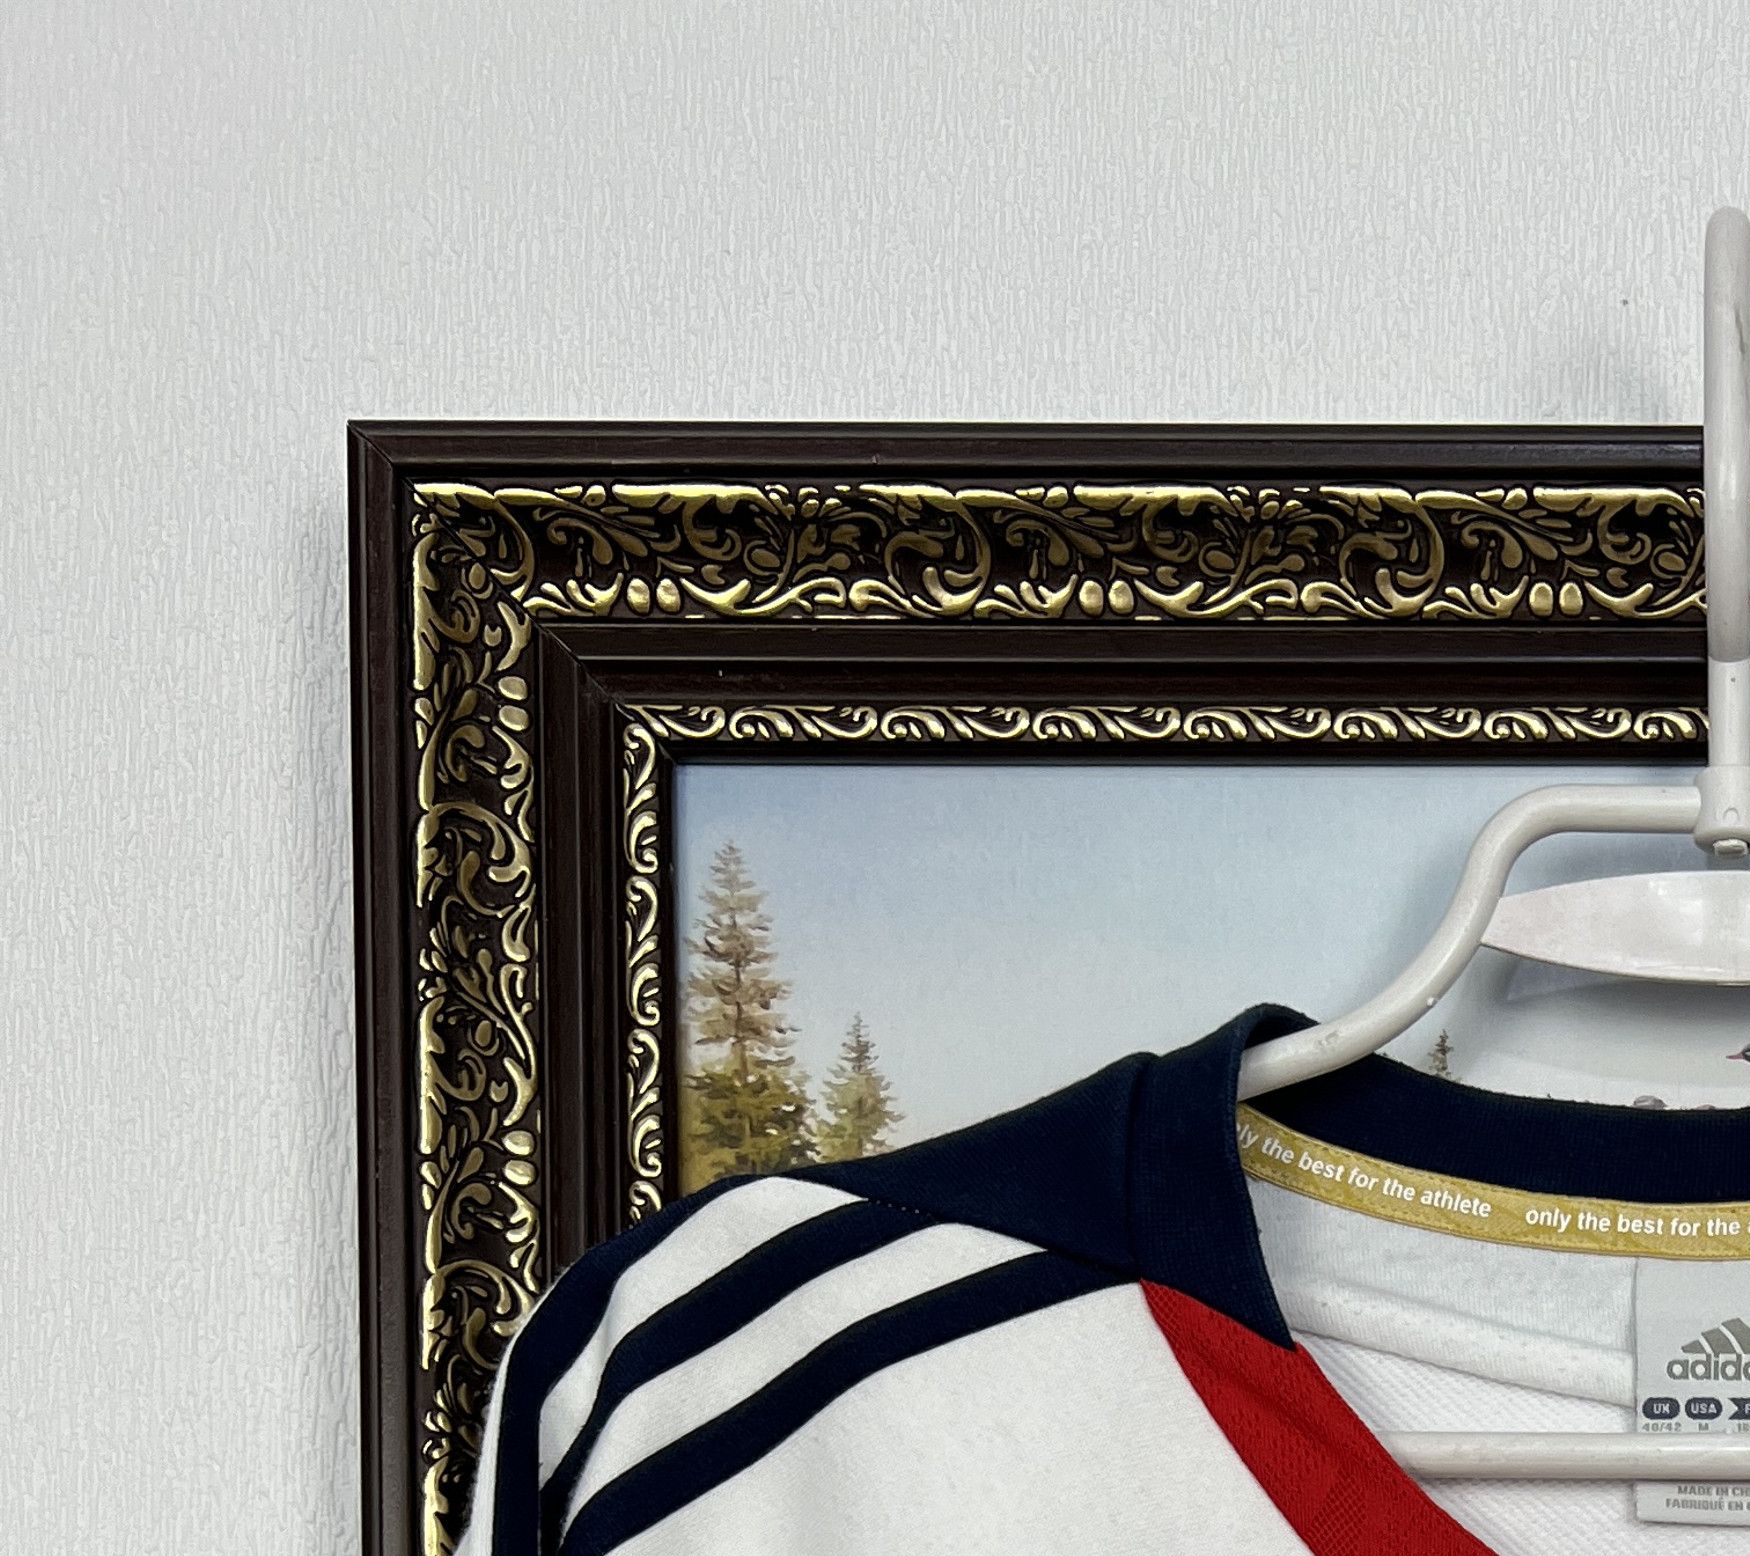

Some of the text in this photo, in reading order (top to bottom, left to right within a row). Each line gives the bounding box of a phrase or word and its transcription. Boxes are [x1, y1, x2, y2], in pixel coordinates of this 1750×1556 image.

[1237, 1122, 1492, 1218] ly the best for the athlete
[1525, 1207, 1572, 1233] only
[1577, 1211, 1611, 1232] the
[1617, 1213, 1664, 1235] best
[1670, 1216, 1702, 1237] for
[1706, 1216, 1741, 1237] the
[1653, 1402, 1670, 1414] UK
[1690, 1402, 1718, 1414] USA
[1642, 1422, 1682, 1432] 40/42
[1698, 1423, 1710, 1432] M
[1677, 1485, 1713, 1496] MADE
[1715, 1486, 1729, 1497] IN
[1727, 1500, 1744, 1511] EN
